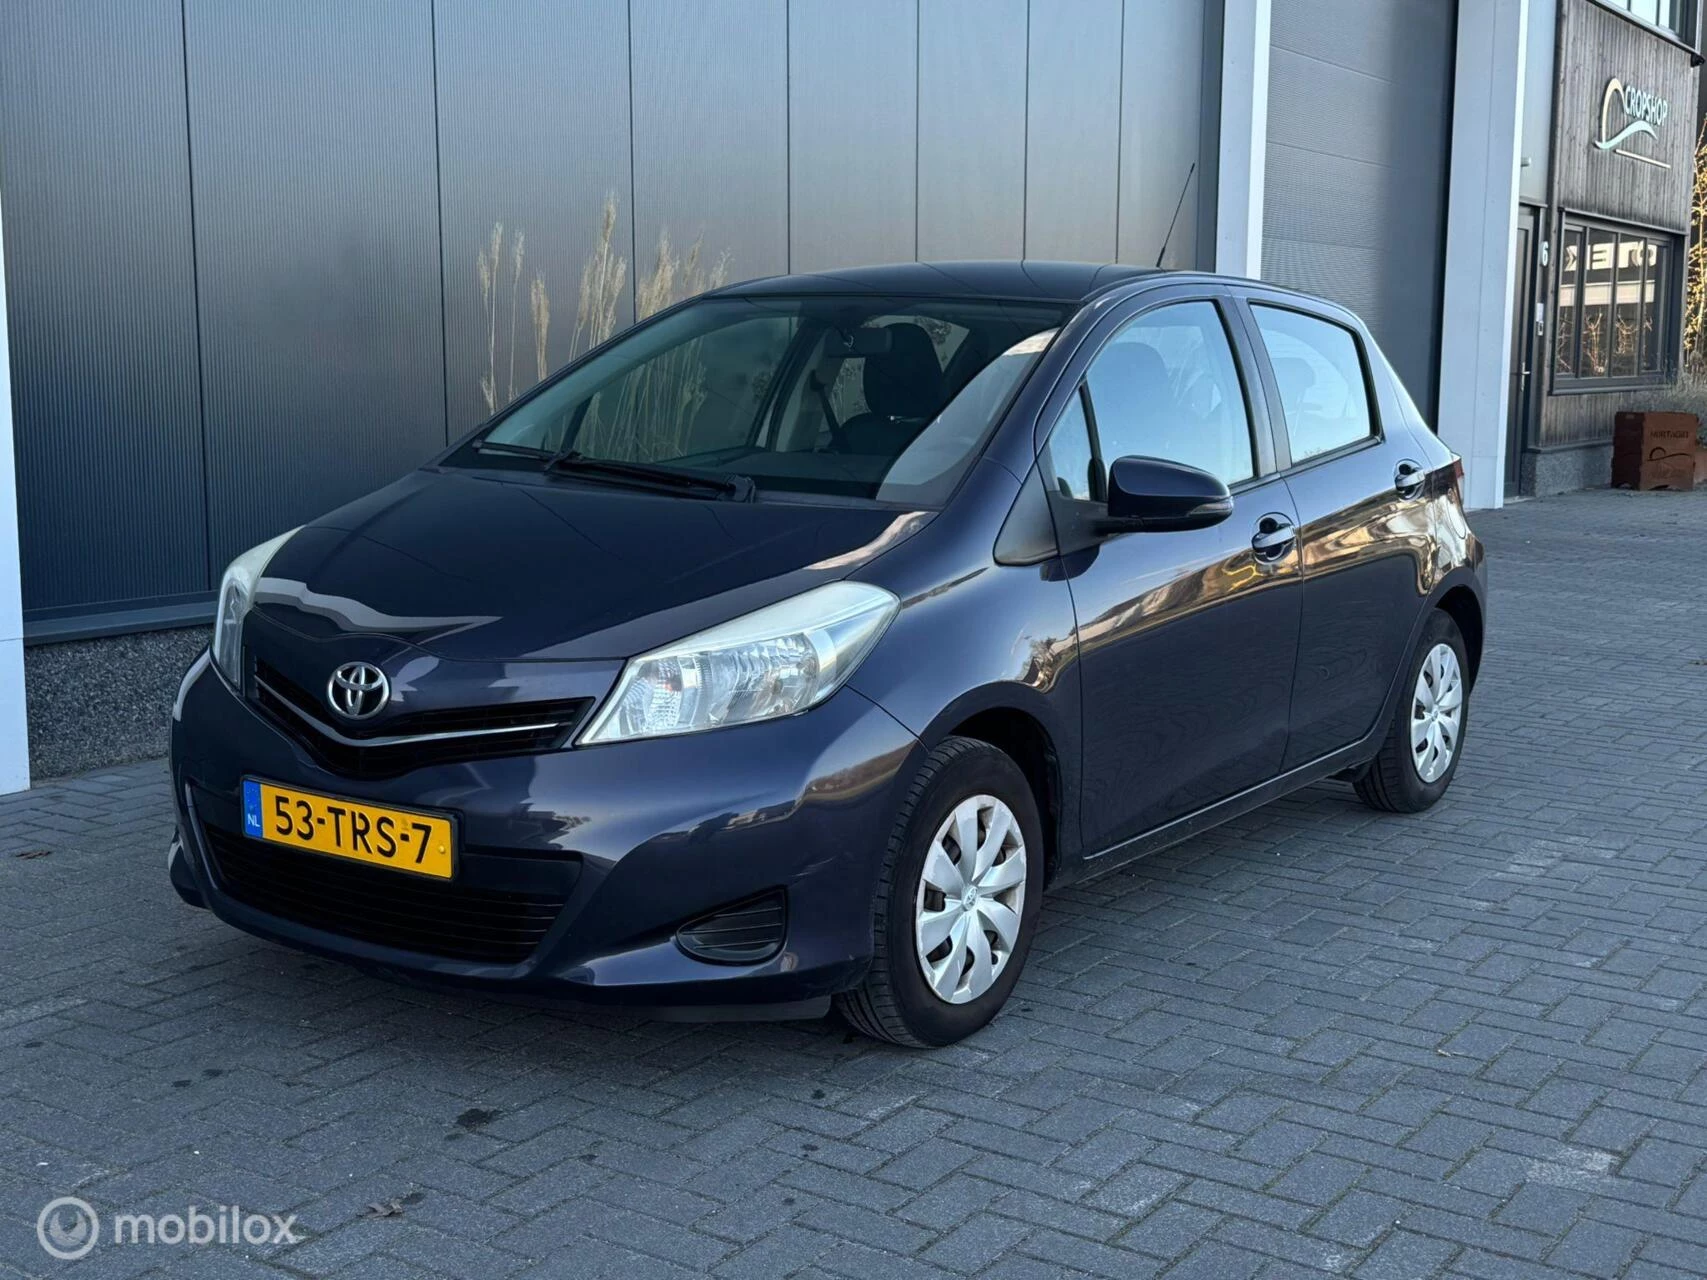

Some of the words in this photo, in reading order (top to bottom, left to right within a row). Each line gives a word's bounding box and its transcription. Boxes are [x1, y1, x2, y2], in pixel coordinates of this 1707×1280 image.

[1625, 85, 1668, 127] CROPSHOP
[1542, 241, 1549, 267] 6
[247, 813, 261, 828] NL
[275, 795, 432, 864] 53-TRS-7
